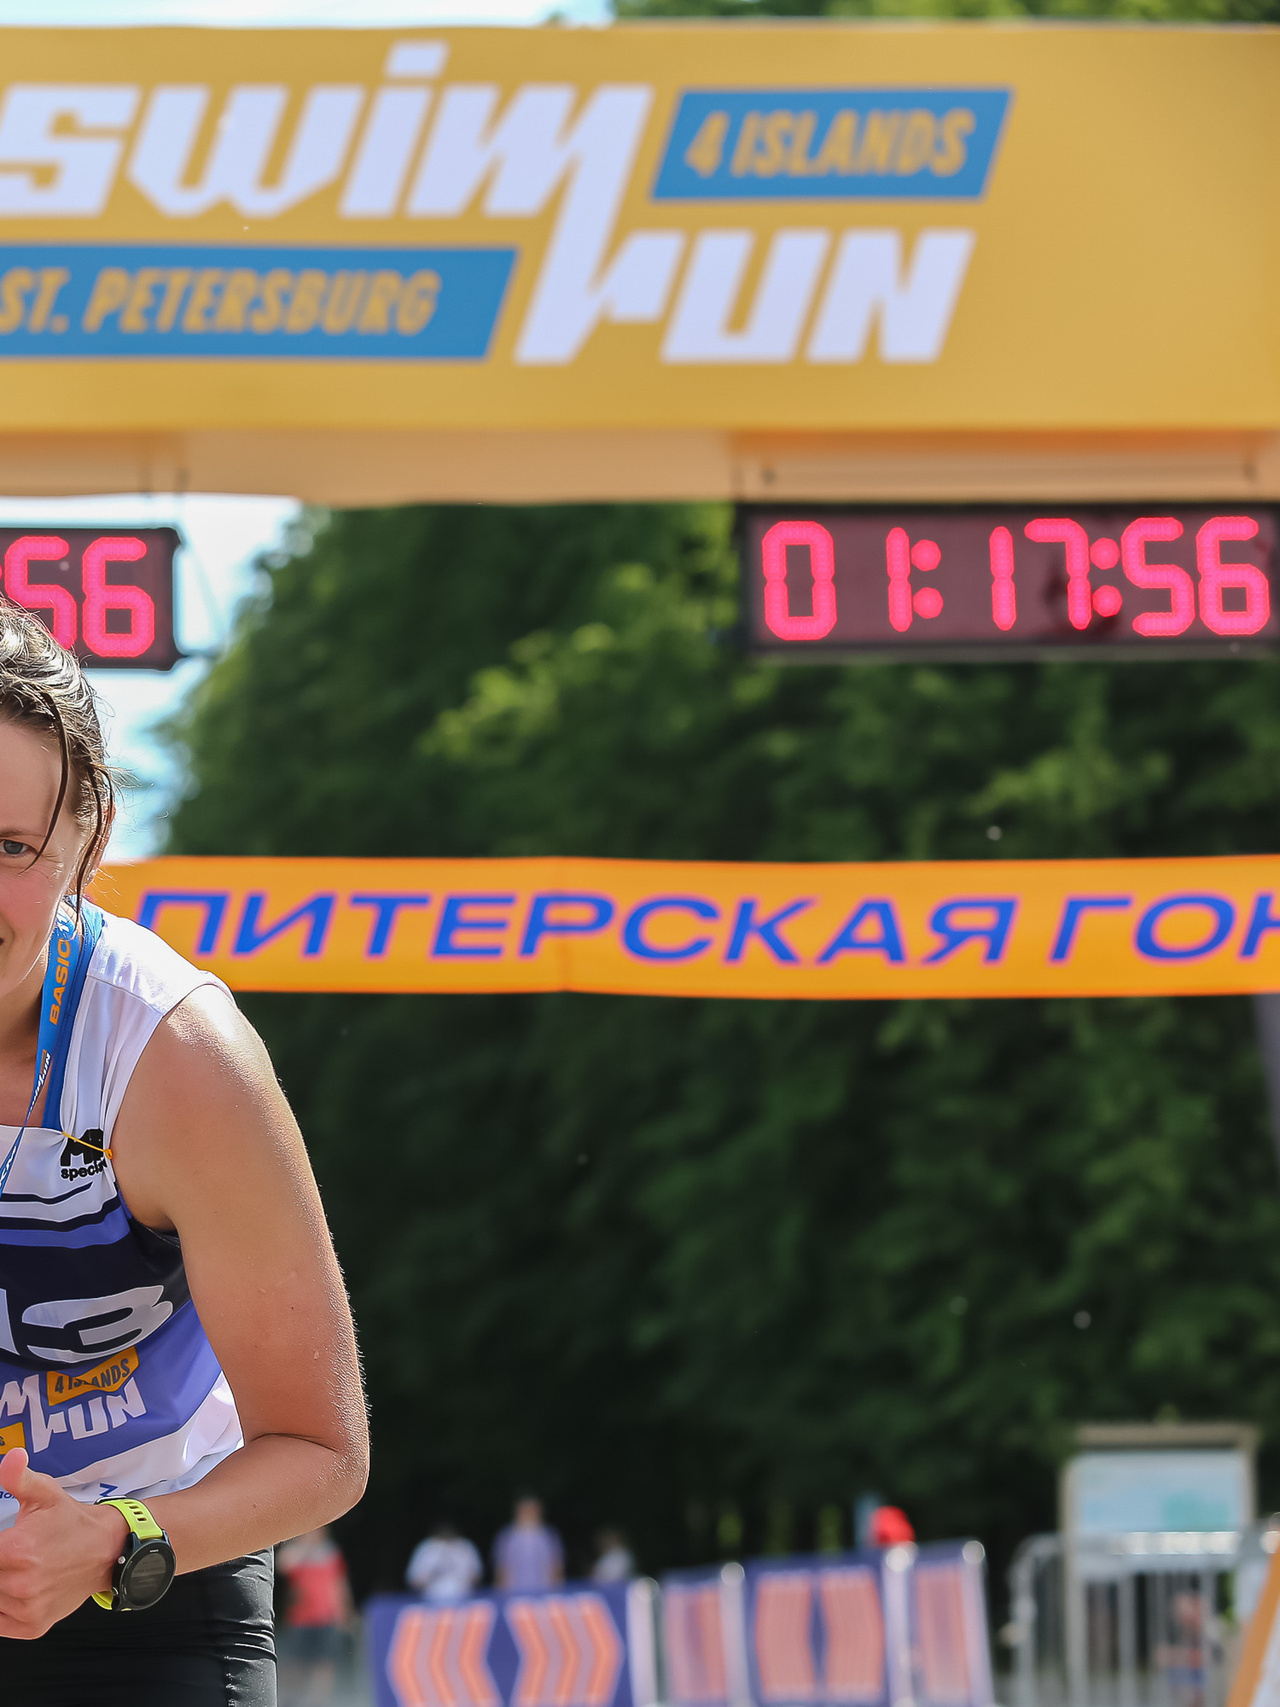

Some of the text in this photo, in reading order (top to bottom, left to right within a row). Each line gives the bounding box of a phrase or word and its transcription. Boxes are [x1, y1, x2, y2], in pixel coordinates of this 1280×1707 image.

[685, 107, 977, 180] 4 ISLANDS
[81, 268, 442, 335] PETERSBURG
[762, 515, 1271, 640] 01:17:56
[136, 891, 1018, 966] ПИТЕРСКАЯ
[49, 937, 71, 1026] BASIC
[55, 1375, 65, 1394] 4
